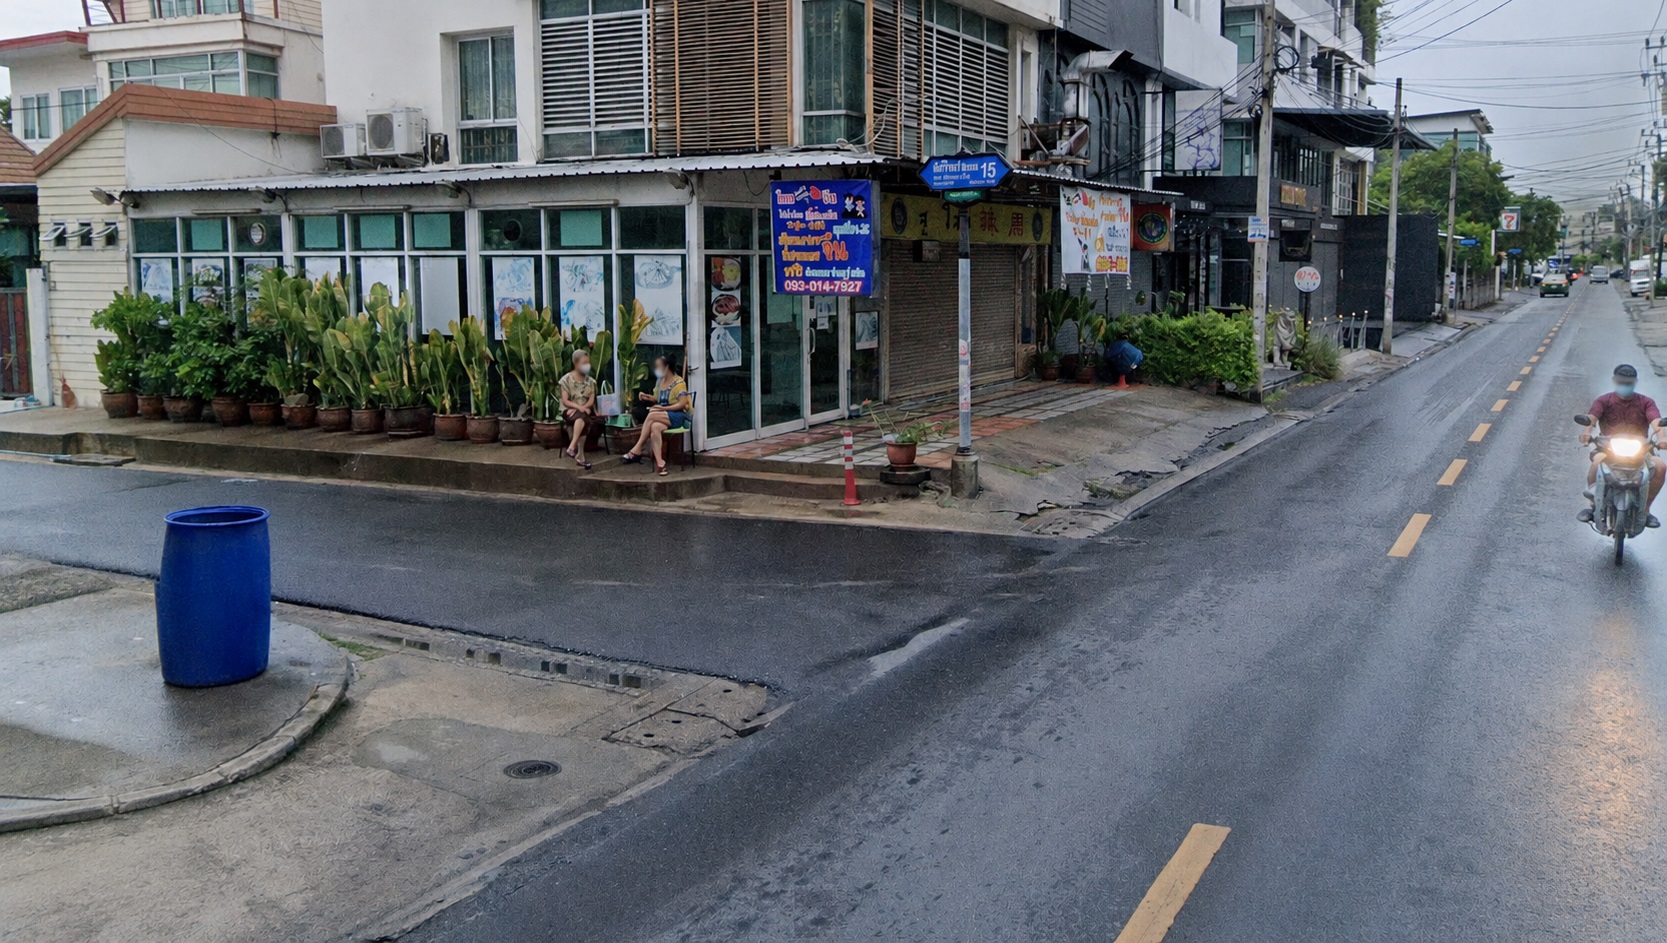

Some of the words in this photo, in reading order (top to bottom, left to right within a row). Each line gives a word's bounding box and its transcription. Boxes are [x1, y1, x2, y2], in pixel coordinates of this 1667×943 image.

[980, 162, 997, 179] 15
[1504, 215, 1515, 229] 7
[784, 280, 863, 292] 093-014-7927
